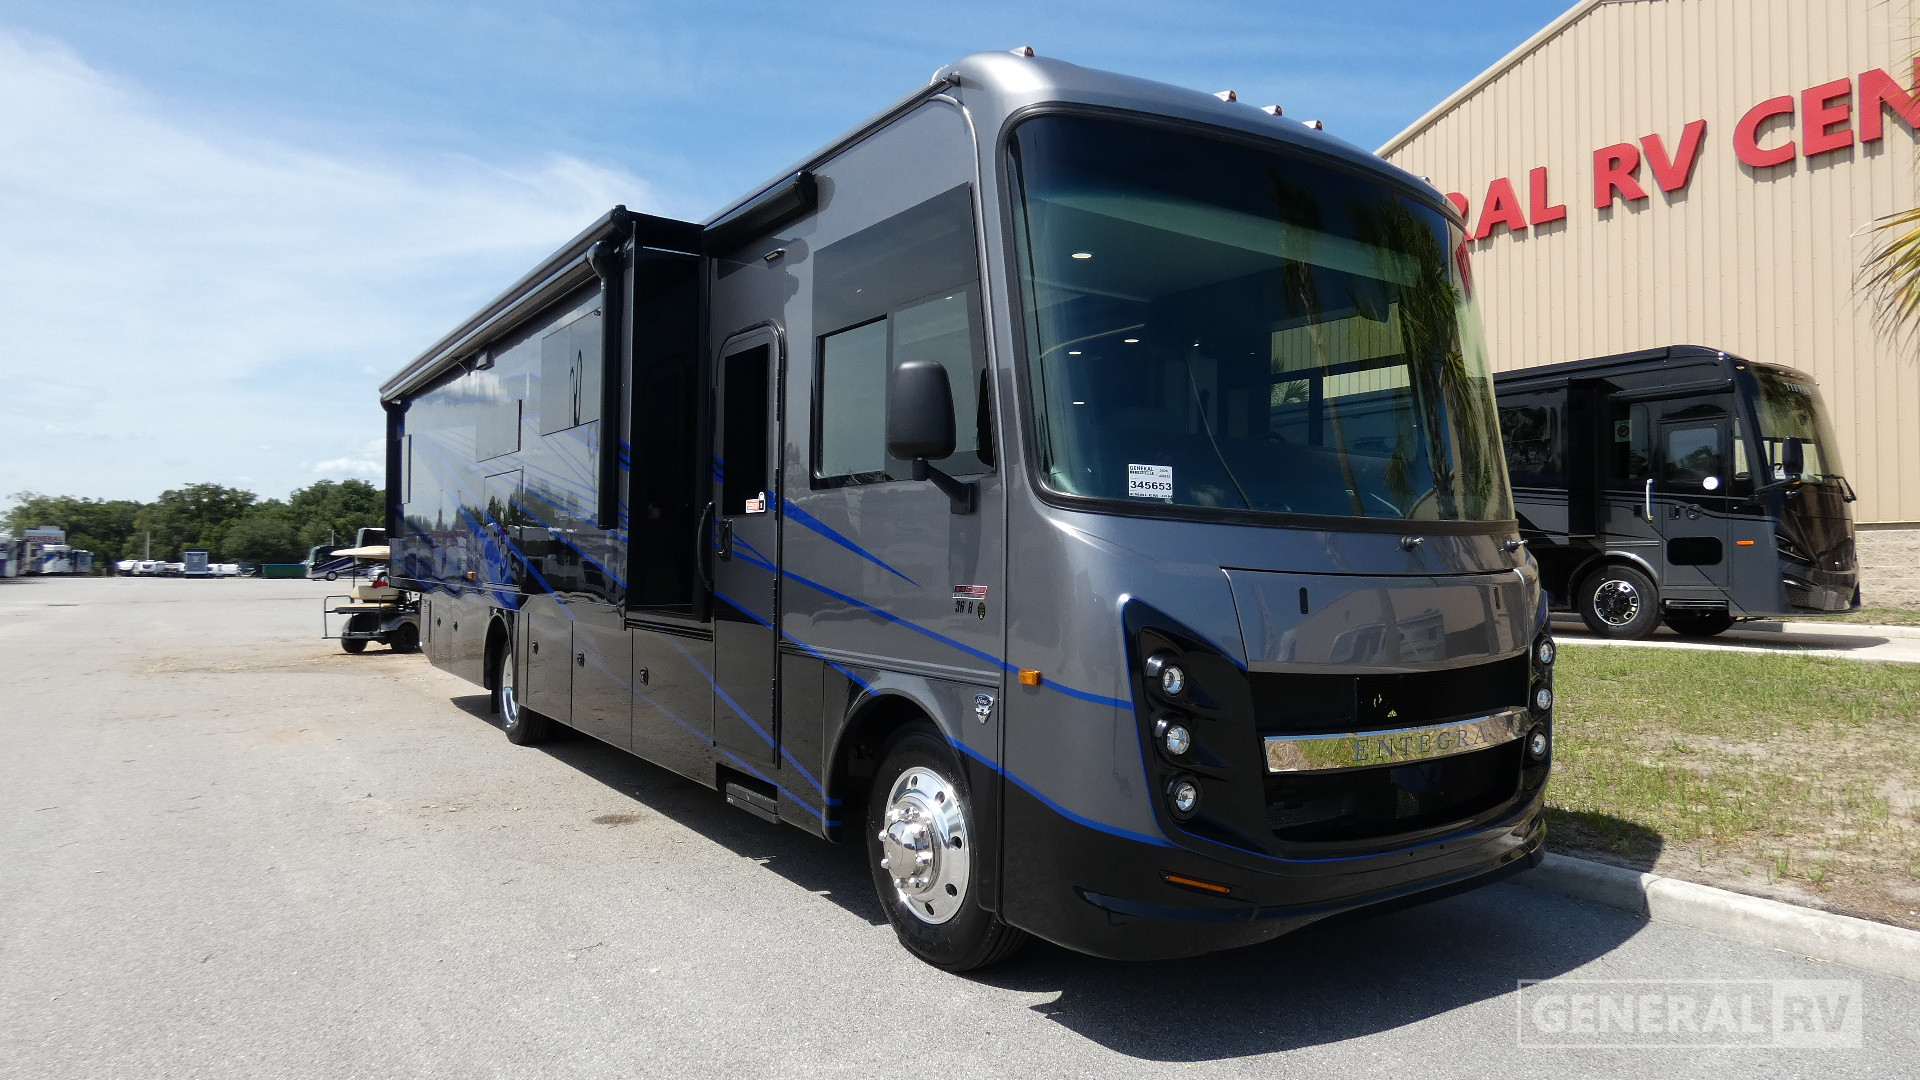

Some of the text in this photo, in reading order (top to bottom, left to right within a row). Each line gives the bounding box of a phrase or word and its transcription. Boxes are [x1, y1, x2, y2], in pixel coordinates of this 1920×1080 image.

[1593, 118, 1707, 209] RV
[1130, 480, 1172, 491] 345653
[955, 600, 965, 614] 36
[1353, 726, 1489, 762] ENTEGRA
